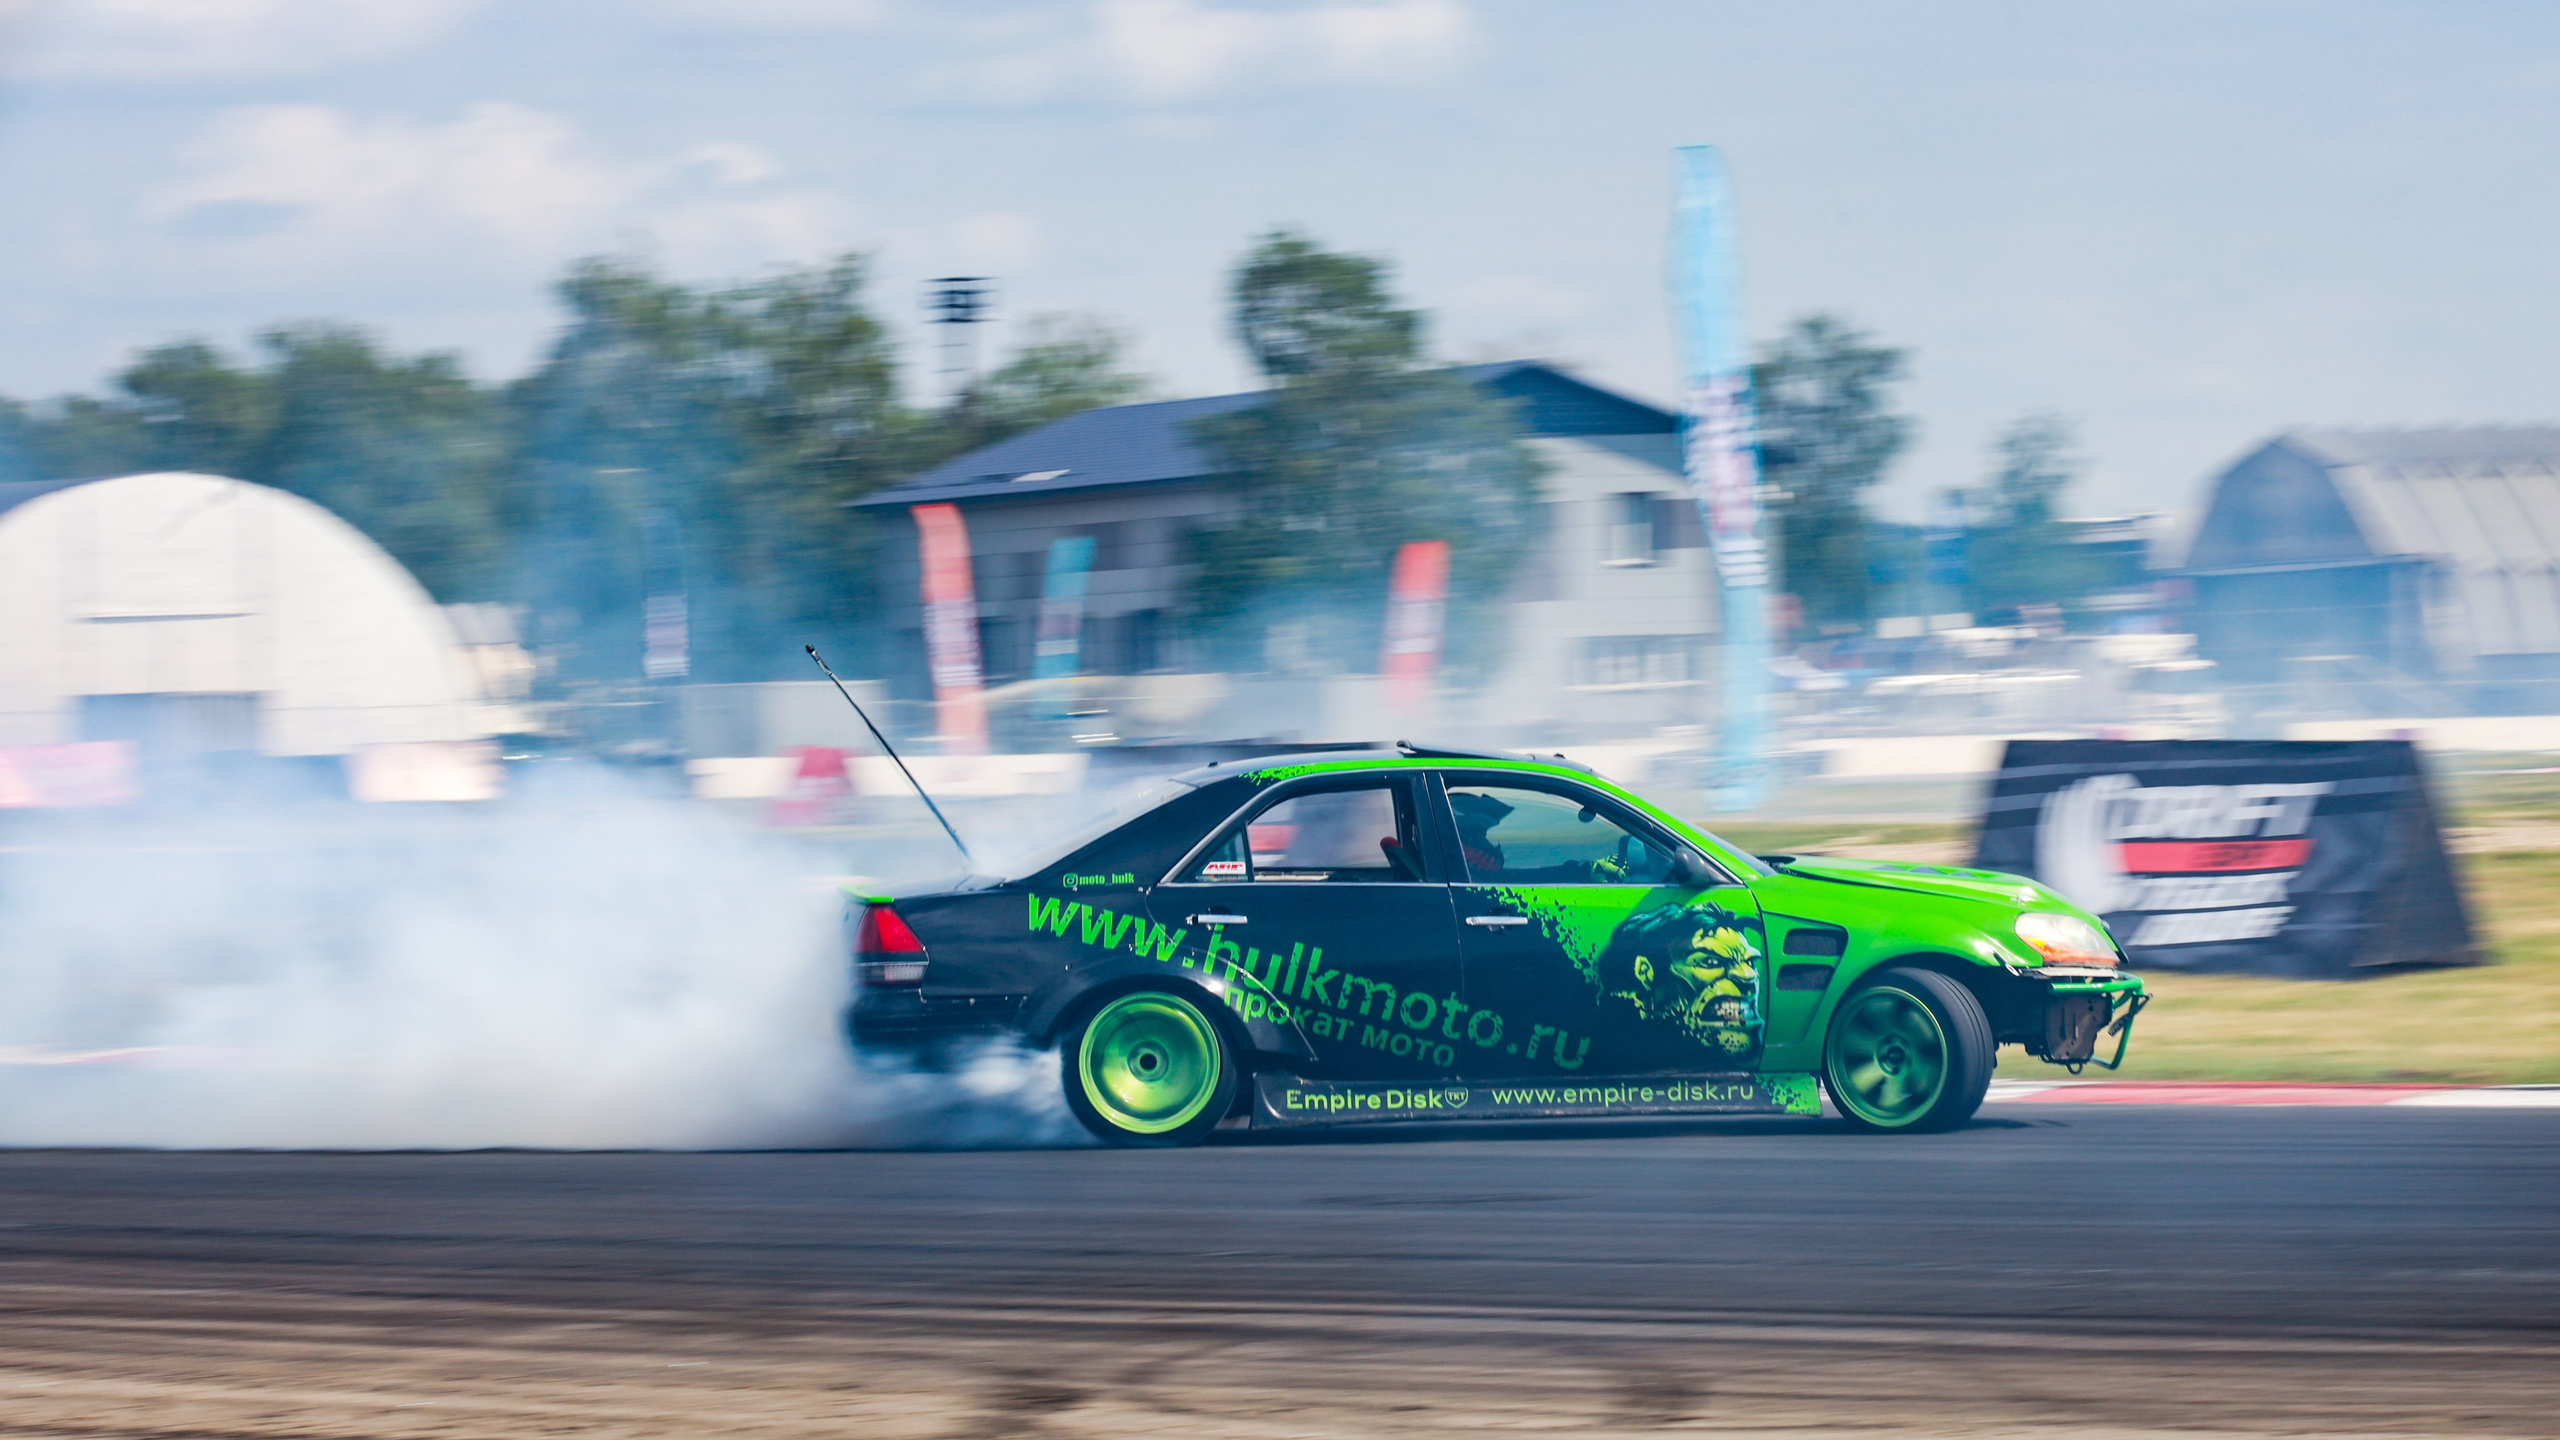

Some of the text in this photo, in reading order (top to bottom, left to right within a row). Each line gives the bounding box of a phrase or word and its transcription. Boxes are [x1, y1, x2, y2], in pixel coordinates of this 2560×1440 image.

[1079, 872, 1134, 886] moto_hulk
[1028, 893, 1590, 1069] www.hulkmoto.ru
[1286, 1089, 1381, 1114] Empire
[1386, 1088, 1443, 1109] Disk
[1491, 1081, 1754, 1107] www.empire-disk.ru
